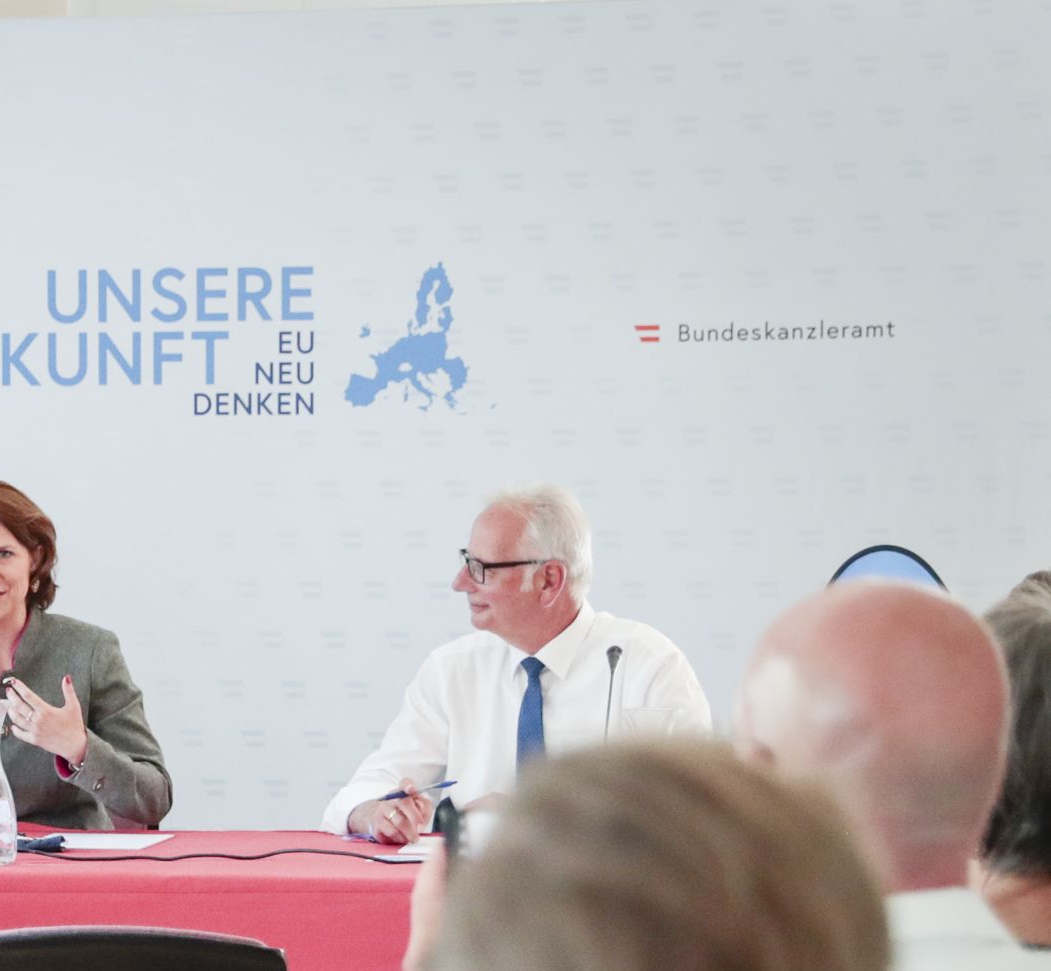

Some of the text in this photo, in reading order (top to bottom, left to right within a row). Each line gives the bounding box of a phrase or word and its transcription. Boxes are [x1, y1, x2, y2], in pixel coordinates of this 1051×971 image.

[47, 265, 315, 323] UNSERE
[278, 330, 315, 355] EU
[677, 319, 896, 342] Bundeskanzleramt
[253, 361, 315, 386] NEU
[192, 391, 315, 417] DENKEN
